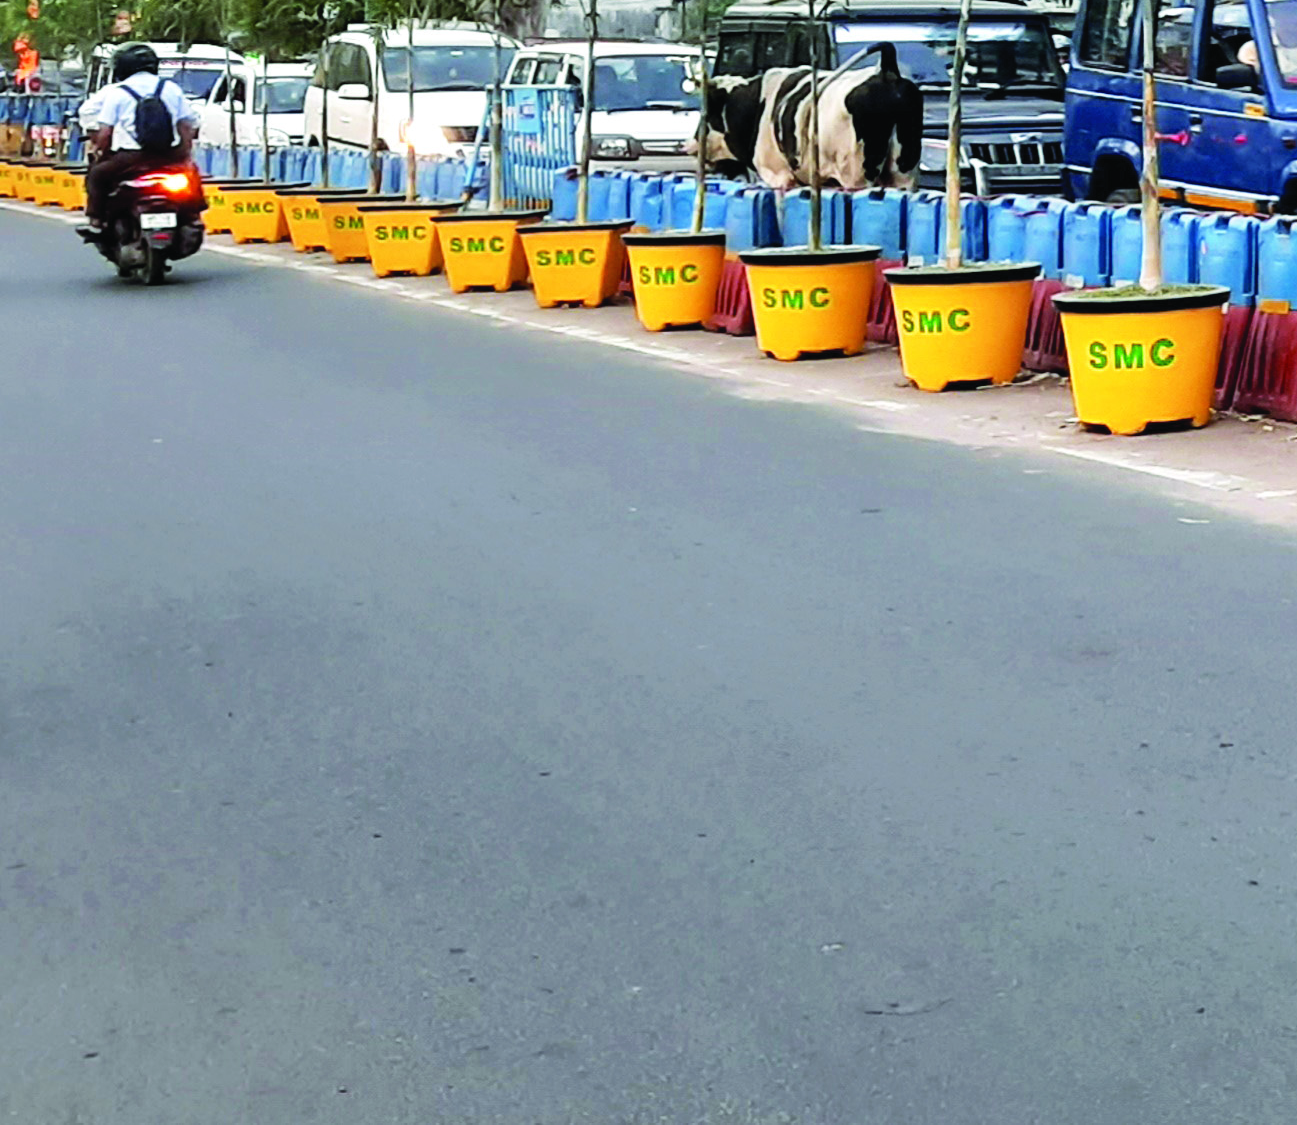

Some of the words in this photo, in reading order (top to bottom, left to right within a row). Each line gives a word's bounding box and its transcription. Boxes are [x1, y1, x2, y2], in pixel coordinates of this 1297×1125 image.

[233, 202, 275, 213] SMC
[292, 208, 319, 220] SM
[334, 216, 364, 229] SM
[375, 226, 426, 240] SMC
[450, 236, 504, 253] SMC
[536, 248, 596, 266] SMC
[639, 264, 698, 285] SMC
[763, 287, 830, 310] SMC
[902, 308, 971, 334] SMC
[1089, 338, 1176, 369] SMC
